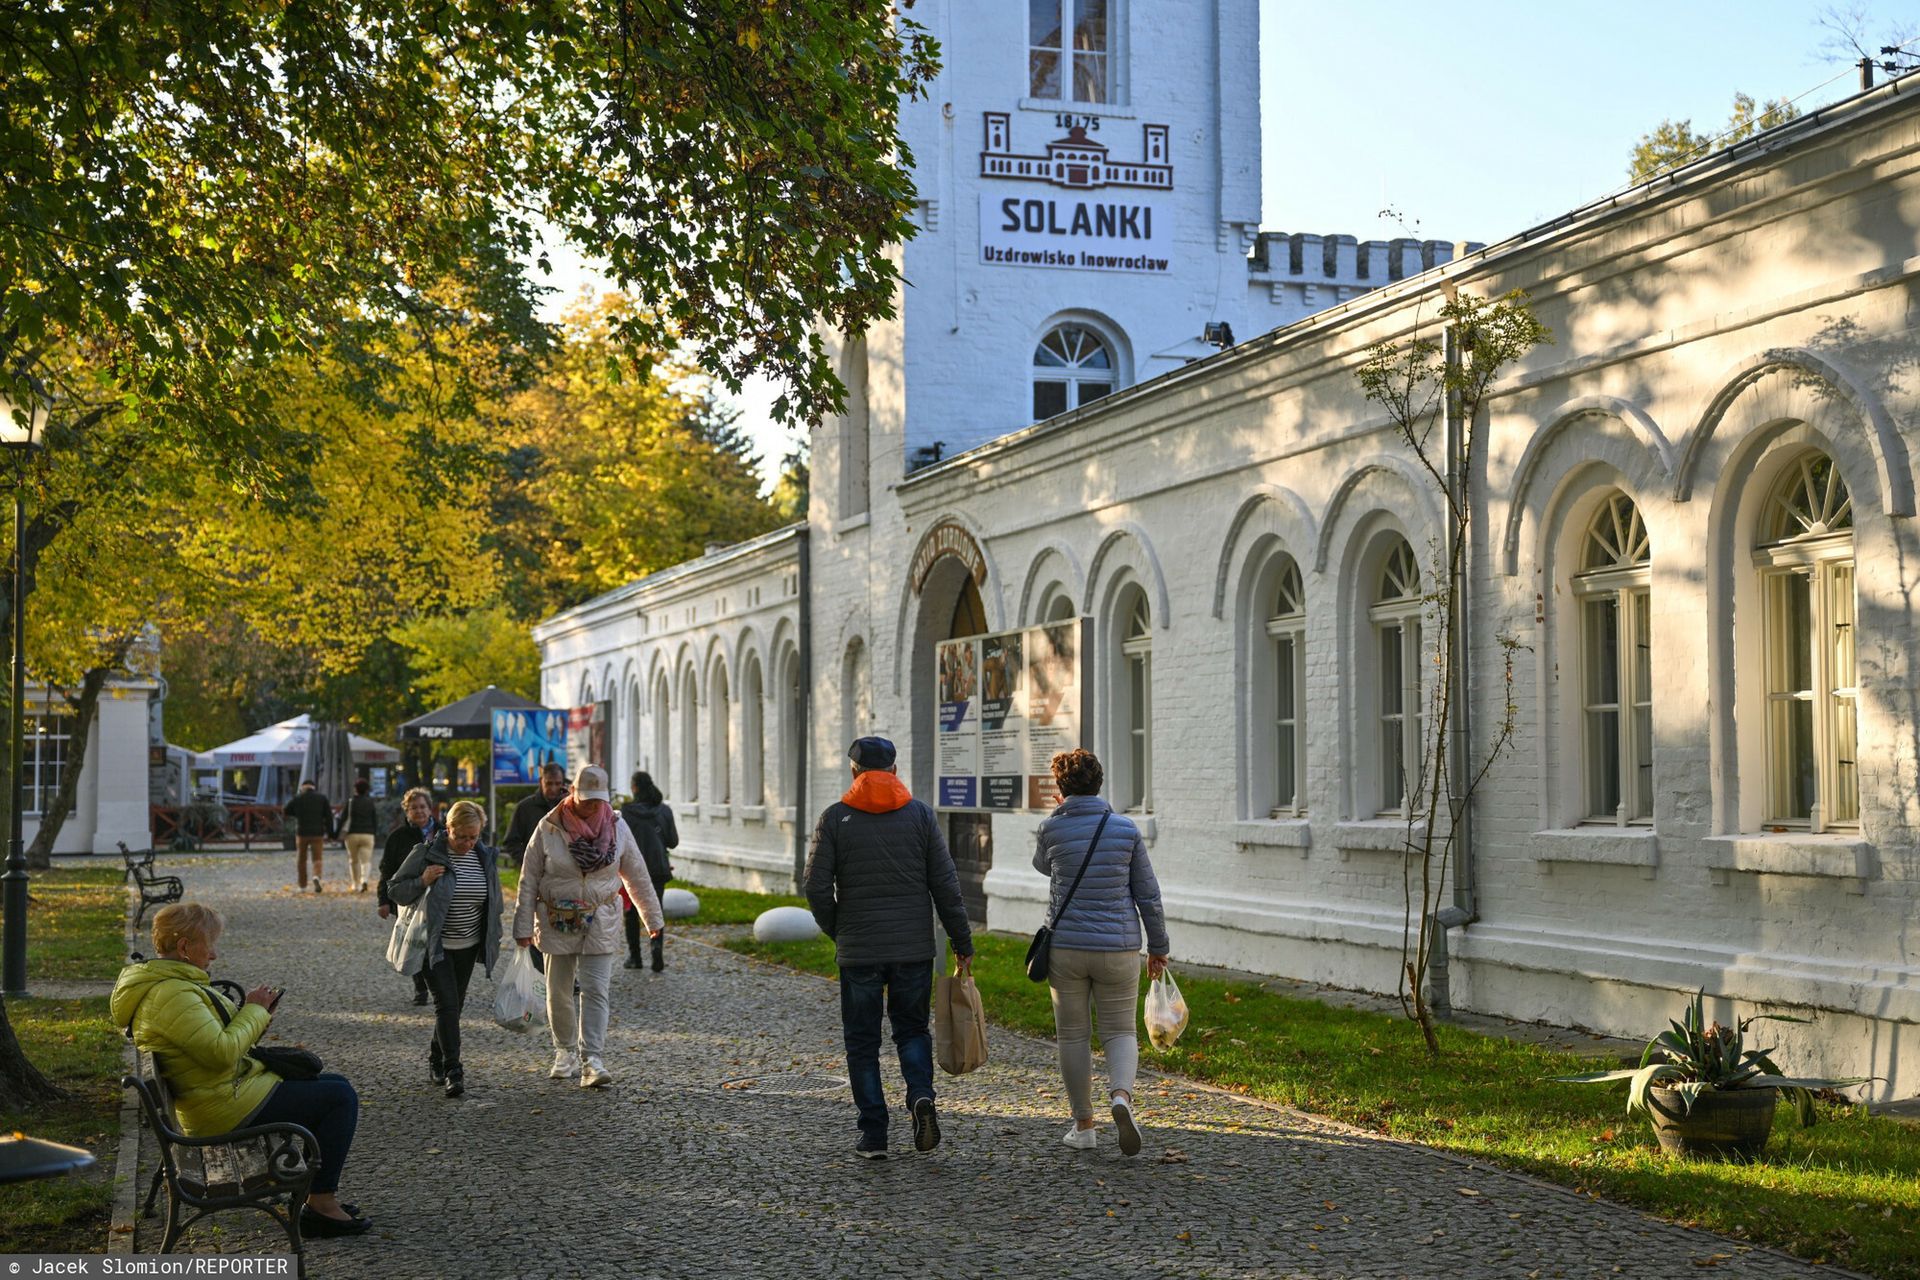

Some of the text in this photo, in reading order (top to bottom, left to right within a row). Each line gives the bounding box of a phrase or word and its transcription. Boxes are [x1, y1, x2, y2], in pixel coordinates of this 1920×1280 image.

[1001, 198, 1151, 240] SOLANKI
[984, 245, 1075, 266] Uzdrowisko
[419, 726, 453, 738] PEPSI
